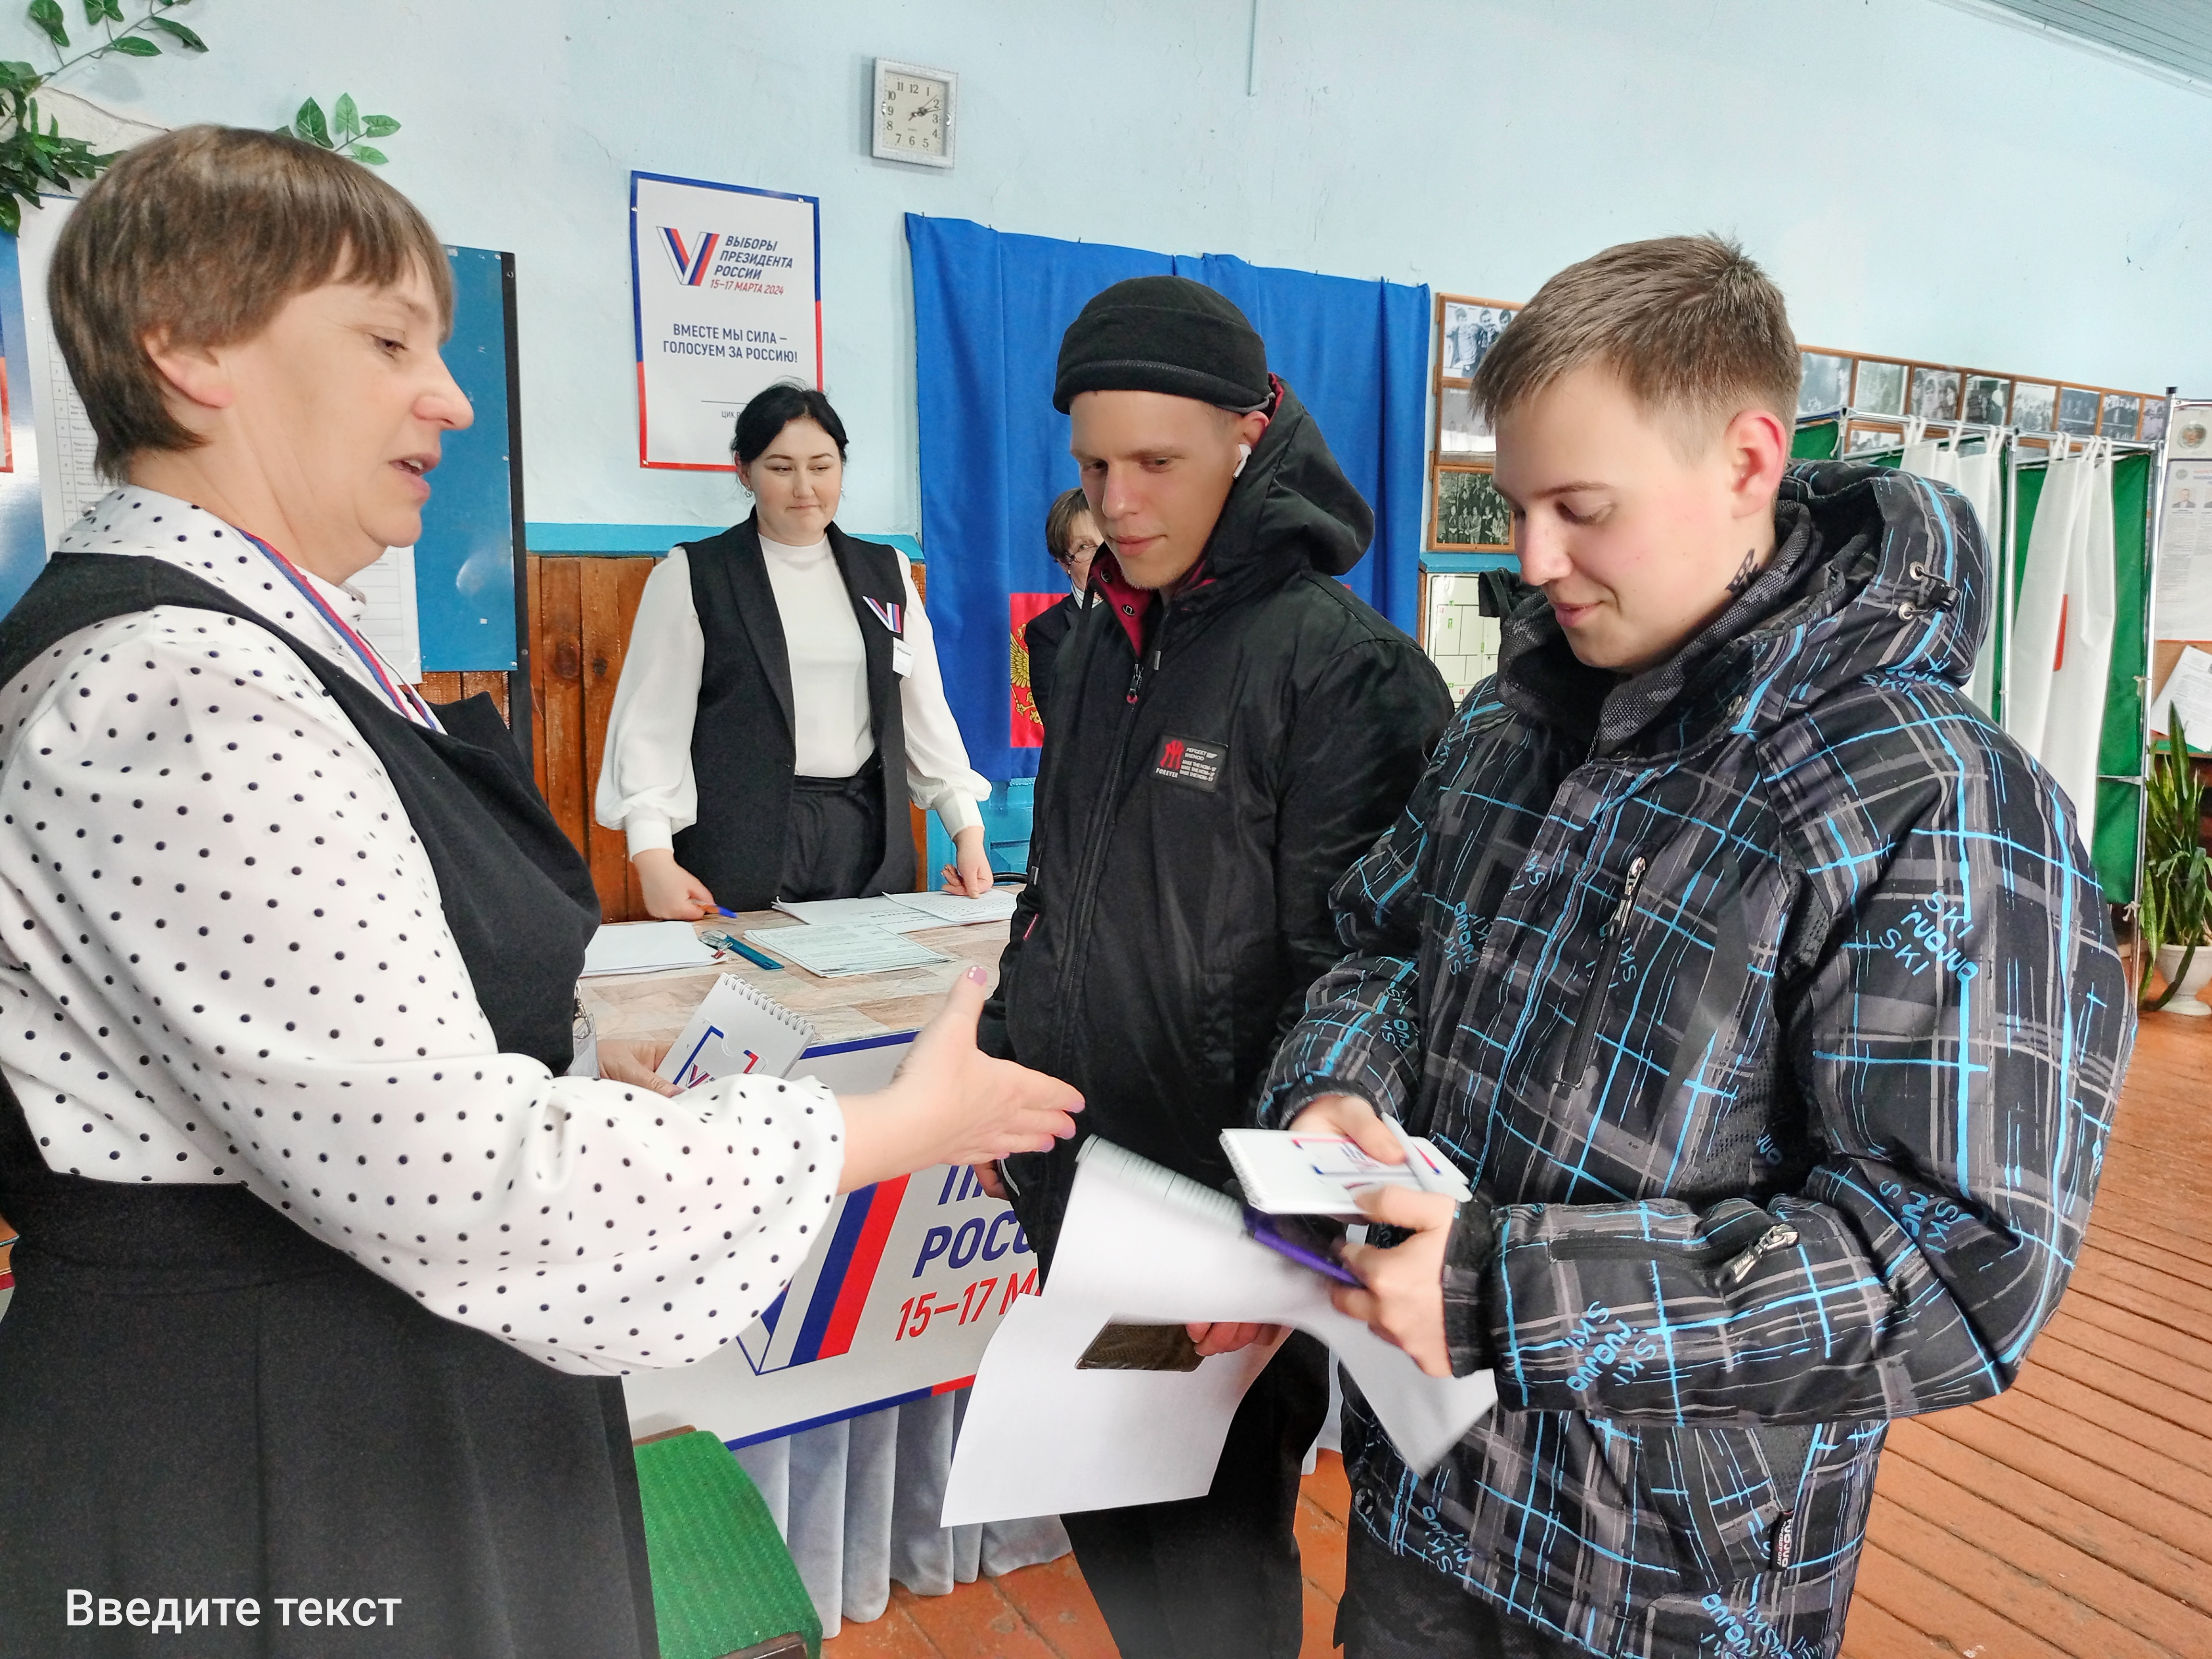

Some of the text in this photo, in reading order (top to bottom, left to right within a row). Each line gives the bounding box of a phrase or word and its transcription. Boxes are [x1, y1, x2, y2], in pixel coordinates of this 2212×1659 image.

[897, 82, 903, 91] 11
[910, 84, 919, 94] 12
[888, 91, 896, 101] 10
[888, 106, 894, 116] 9
[933, 99, 939, 109] 2
[887, 120, 893, 131] 8
[932, 114, 938, 124] 3
[896, 133, 902, 144] 7
[909, 136, 915, 146] 6
[932, 129, 938, 138] 4
[922, 138, 929, 148] 5
[725, 236, 778, 252] ВЫБОРЫ
[720, 250, 793, 268] ПРЕЗИДЕНТА
[714, 264, 762, 280] РОССИИ
[734, 281, 763, 293] МАРТА
[764, 285, 784, 295] 2024
[673, 323, 719, 339] ВМЕСТЕ
[722, 328, 743, 341] МЫ
[746, 330, 777, 344] СИЛА
[663, 340, 798, 363] ГОЛОСУЕМ ЗА РОССИЮ!
[1155, 768, 1178, 779] FOREVER
[1924, 891, 1974, 939] SKI
[1444, 936, 1461, 975] SKI
[1879, 928, 1930, 976] SKI
[1620, 937, 1637, 983] SKI
[1925, 1201, 1959, 1253] SKI
[1565, 1300, 1610, 1351] SKI
[1612, 1337, 1657, 1384] SKI
[1742, 1606, 1780, 1646] SKI
